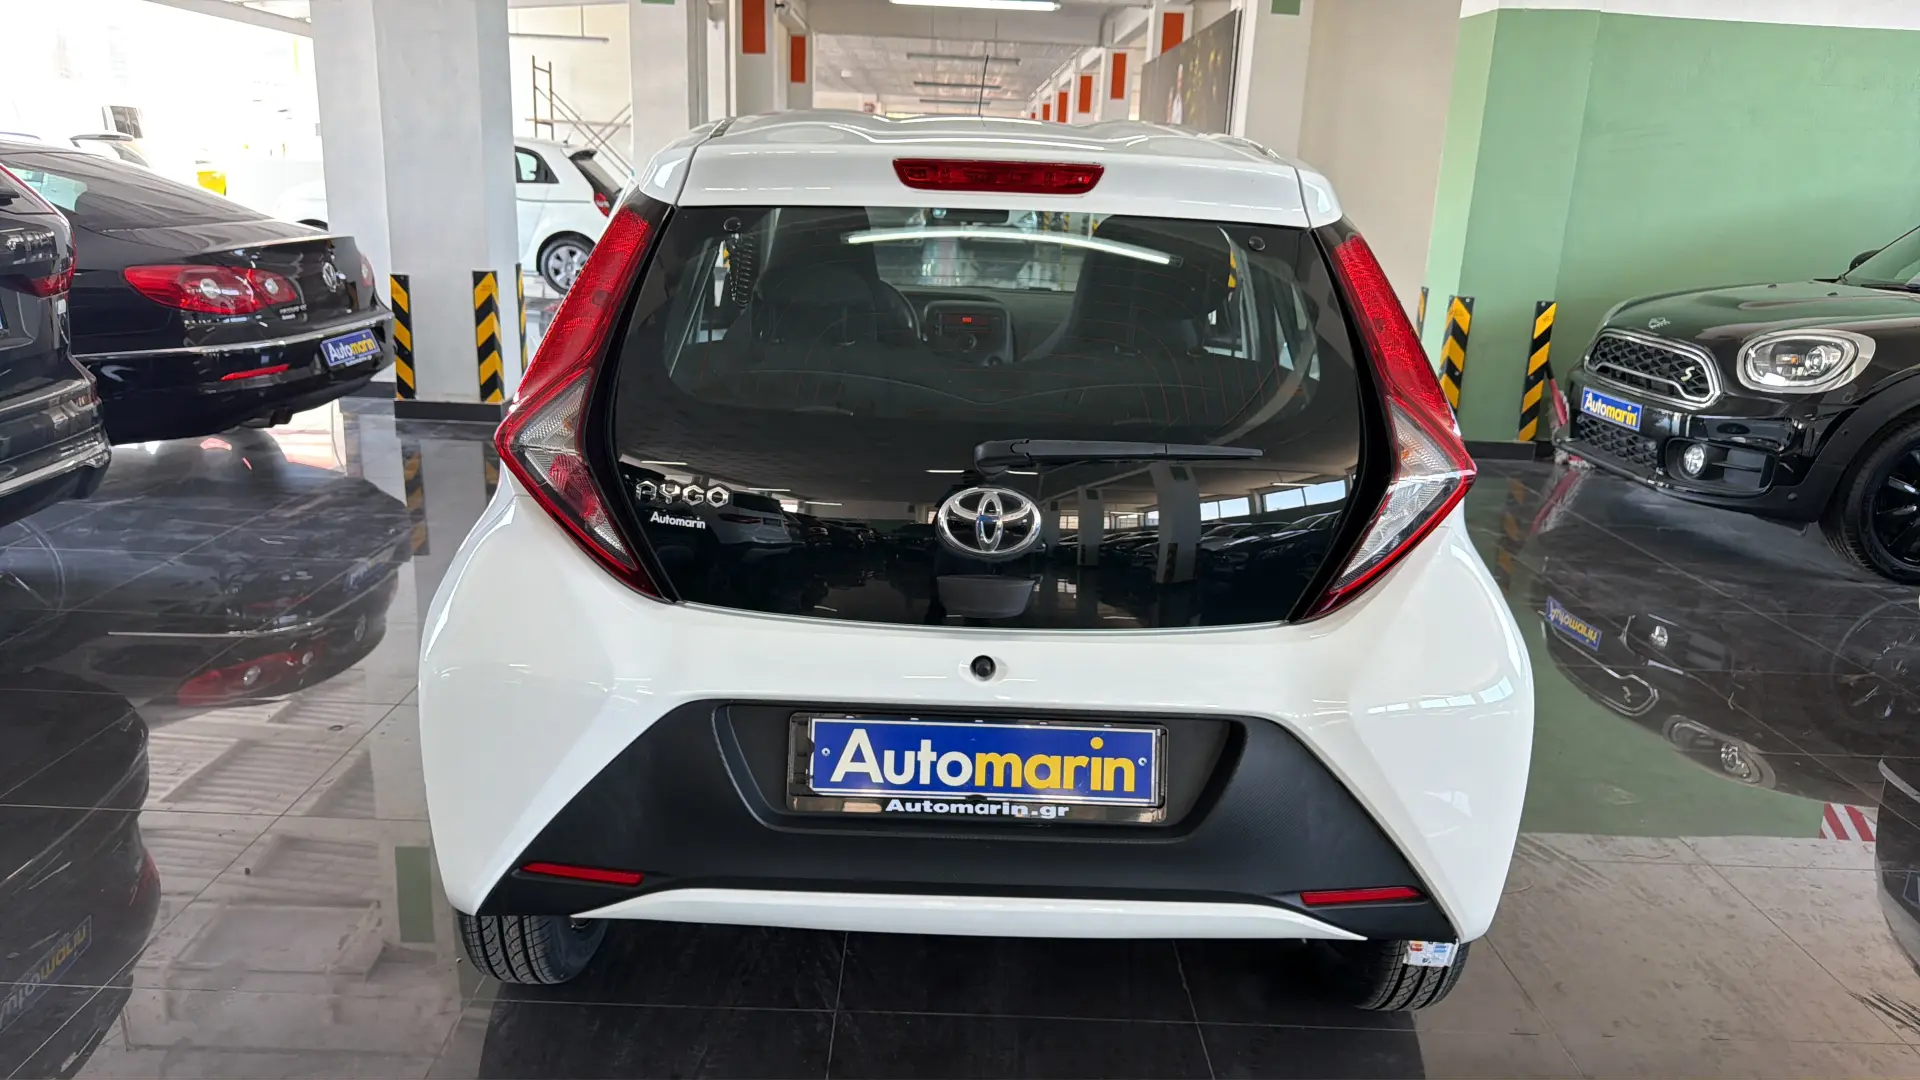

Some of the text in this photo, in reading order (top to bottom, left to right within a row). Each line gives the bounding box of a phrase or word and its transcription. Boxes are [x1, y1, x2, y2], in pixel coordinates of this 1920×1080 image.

[1583, 393, 1638, 427] Automarin
[636, 480, 730, 508] AYGO
[650, 511, 706, 529] Automarin
[830, 728, 1136, 792] Automarin
[885, 799, 1070, 819] Automarin.gr
